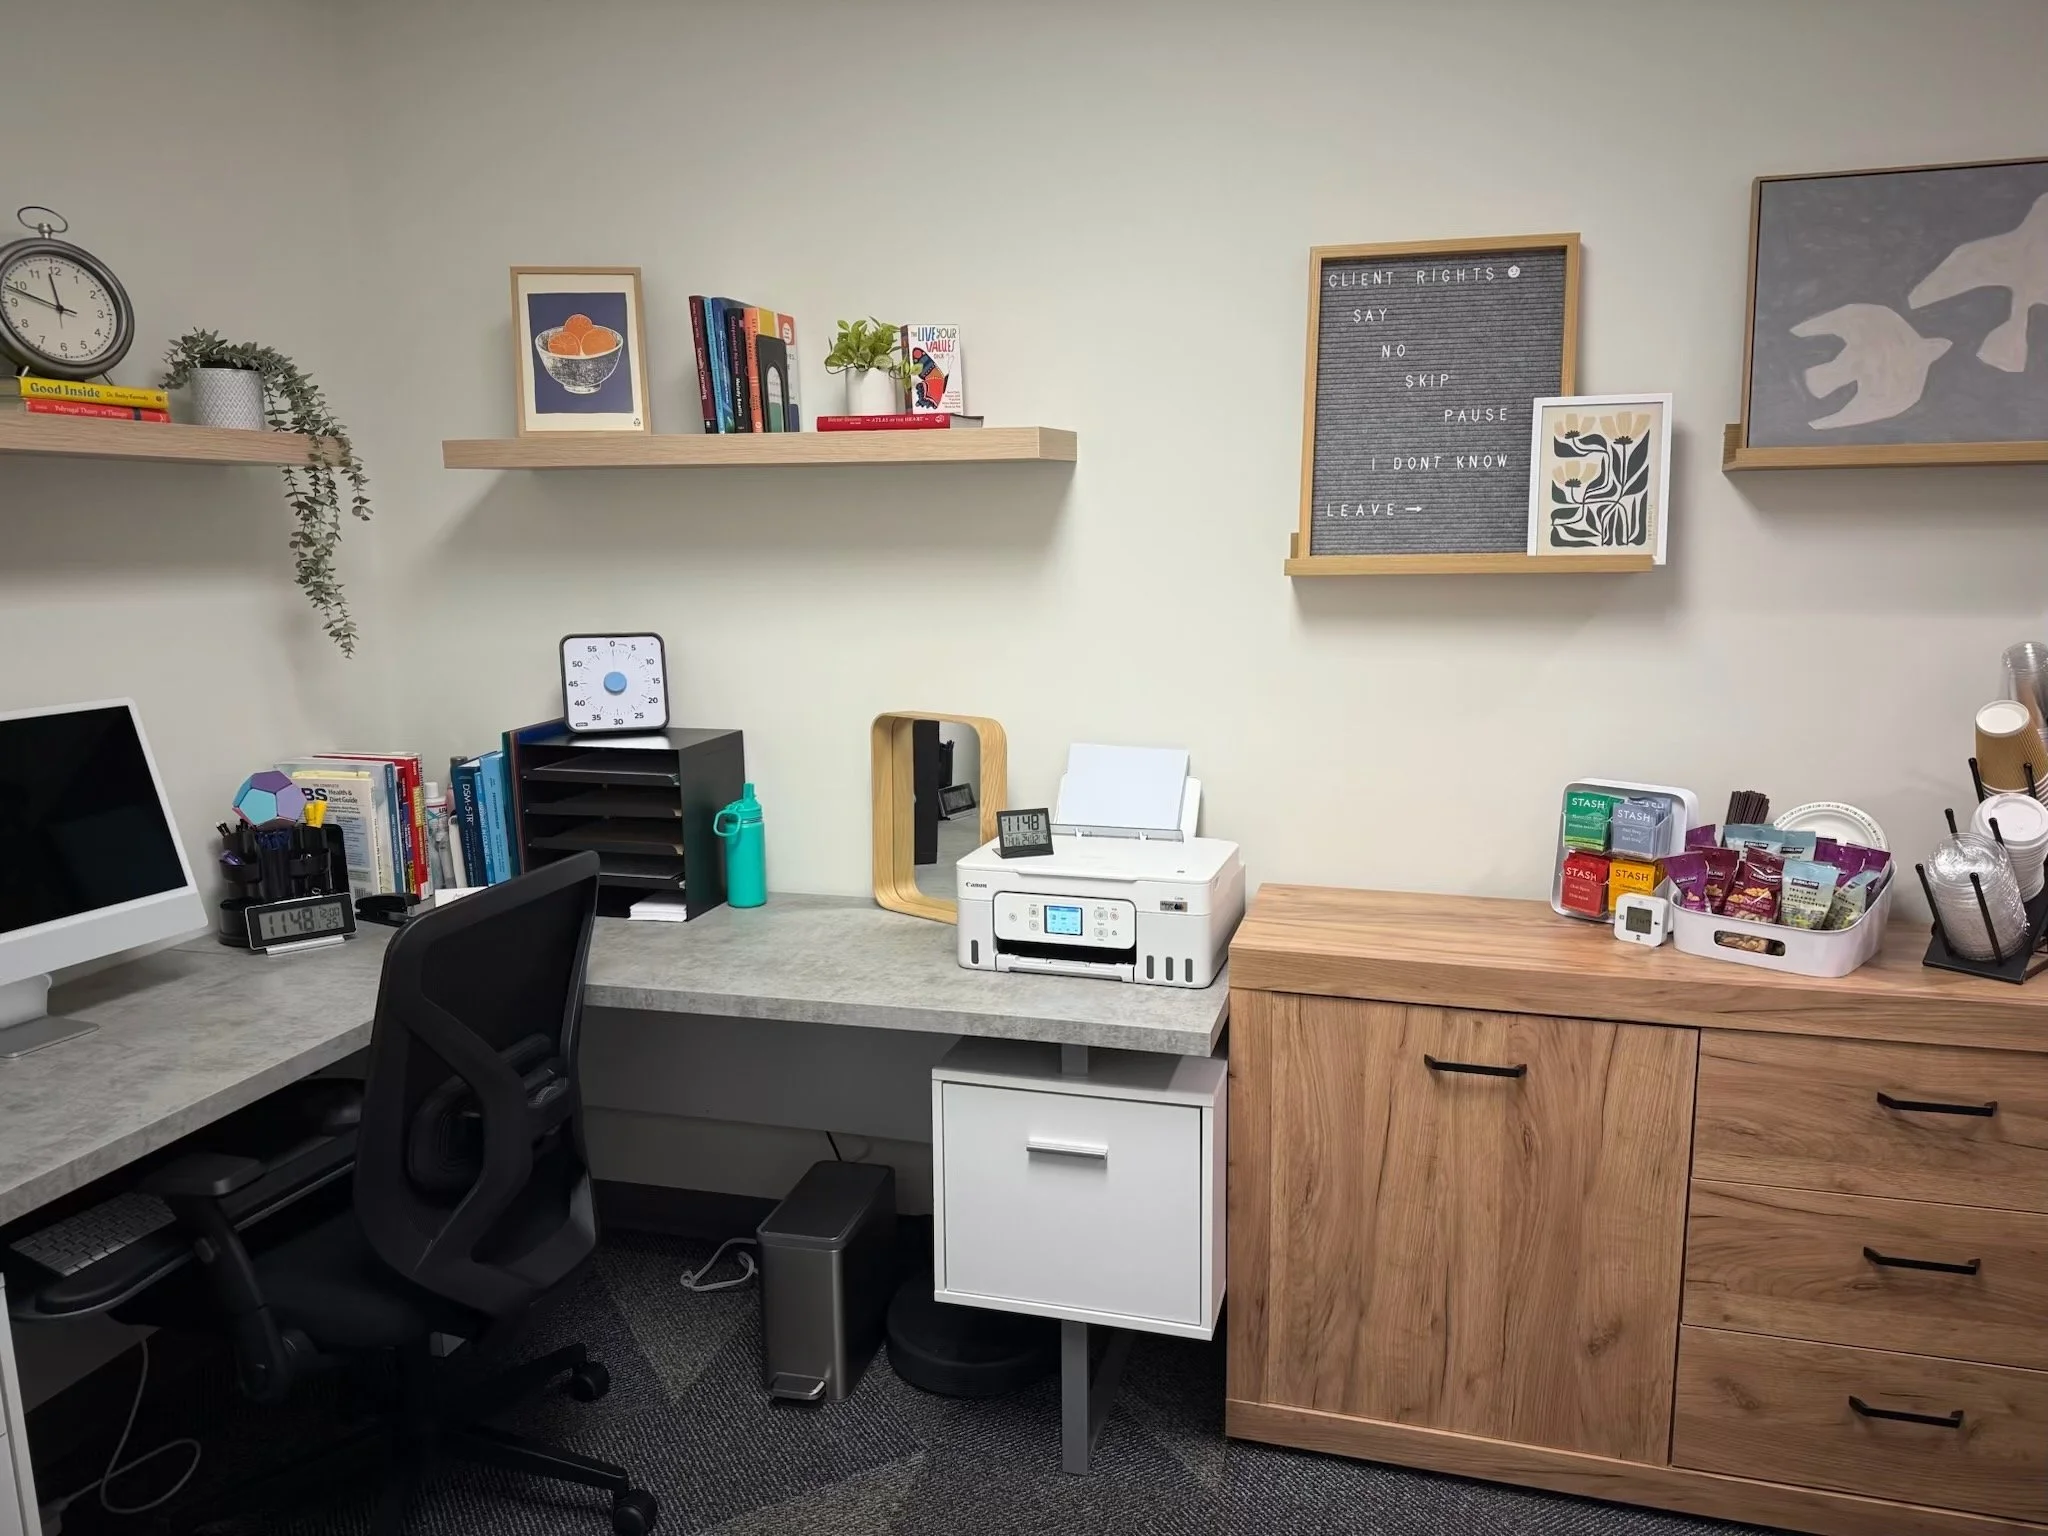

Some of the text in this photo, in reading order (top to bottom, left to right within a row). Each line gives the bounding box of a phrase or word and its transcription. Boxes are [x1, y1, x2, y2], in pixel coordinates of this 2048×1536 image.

[29, 269, 40, 279] 11
[48, 266, 61, 276] 12
[74, 276, 78, 284] 1
[1329, 267, 1494, 288] CLIENT RIGHTS
[14, 281, 27, 290] 10
[90, 290, 96, 299] 2
[10, 298, 18, 307] 9
[97, 310, 104, 318] 3
[1353, 308, 1388, 324] SAY
[21, 319, 28, 328] 8
[94, 328, 101, 336] 4
[730, 316, 738, 351] Codependent
[918, 327, 935, 342] LIVE
[936, 328, 957, 339] YOUR
[40, 335, 45, 344] 7
[80, 340, 87, 349] 5
[61, 343, 67, 351] 6
[925, 340, 955, 352] VALUES
[1382, 344, 1405, 358] NO
[1405, 374, 1449, 389] SKIP
[30, 382, 100, 398] Good Inside
[1444, 408, 1508, 423] PAUSE
[1371, 455, 1508, 470] I DONT KNOW
[1327, 503, 1395, 517] LEAVE
[301, 788, 328, 801] BS
[414, 787, 423, 827] Nutrition
[1572, 798, 1605, 809] STASH
[1617, 809, 1651, 822] STASH
[1566, 867, 1597, 881] STASH
[1616, 870, 1649, 881] STASH
[1793, 879, 1819, 887] KIRKLAND
